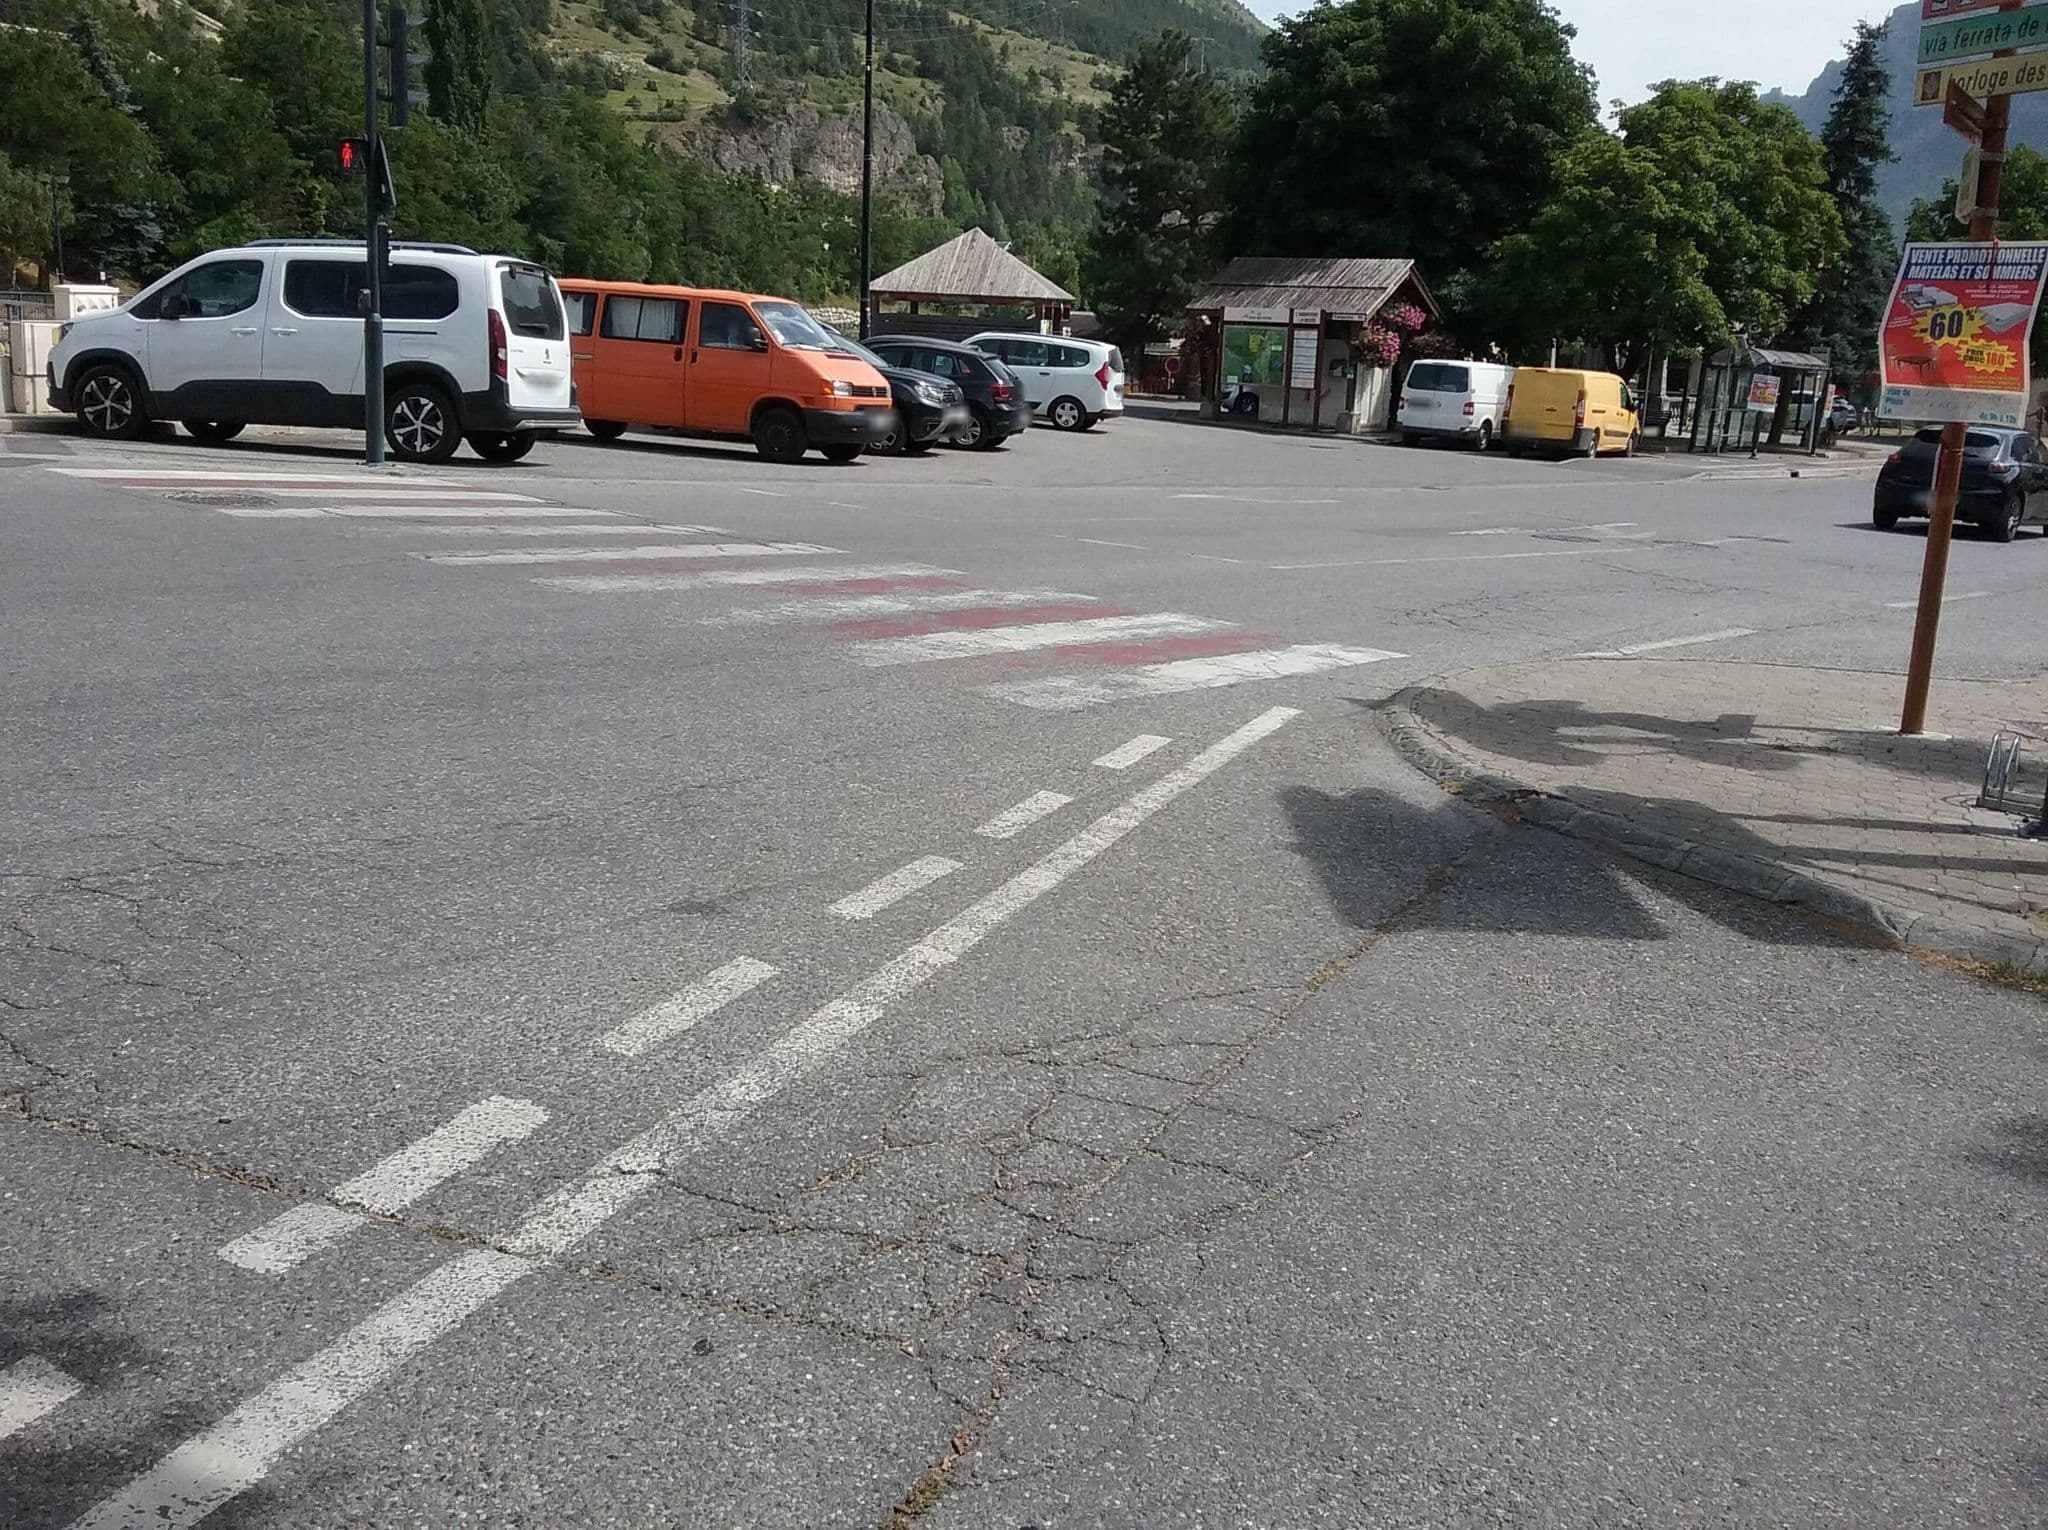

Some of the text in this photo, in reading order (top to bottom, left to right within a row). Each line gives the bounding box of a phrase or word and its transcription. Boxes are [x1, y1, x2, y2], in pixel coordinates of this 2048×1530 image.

[1925, 32, 1948, 55] via
[1953, 23, 2012, 50] ferrata
[2018, 15, 2040, 39] de
[2015, 61, 2047, 85] des
[1911, 248, 2046, 264] VENTE PROMOTIONNELLE
[1907, 264, 2038, 280] MATELAS ET SOMMIERS
